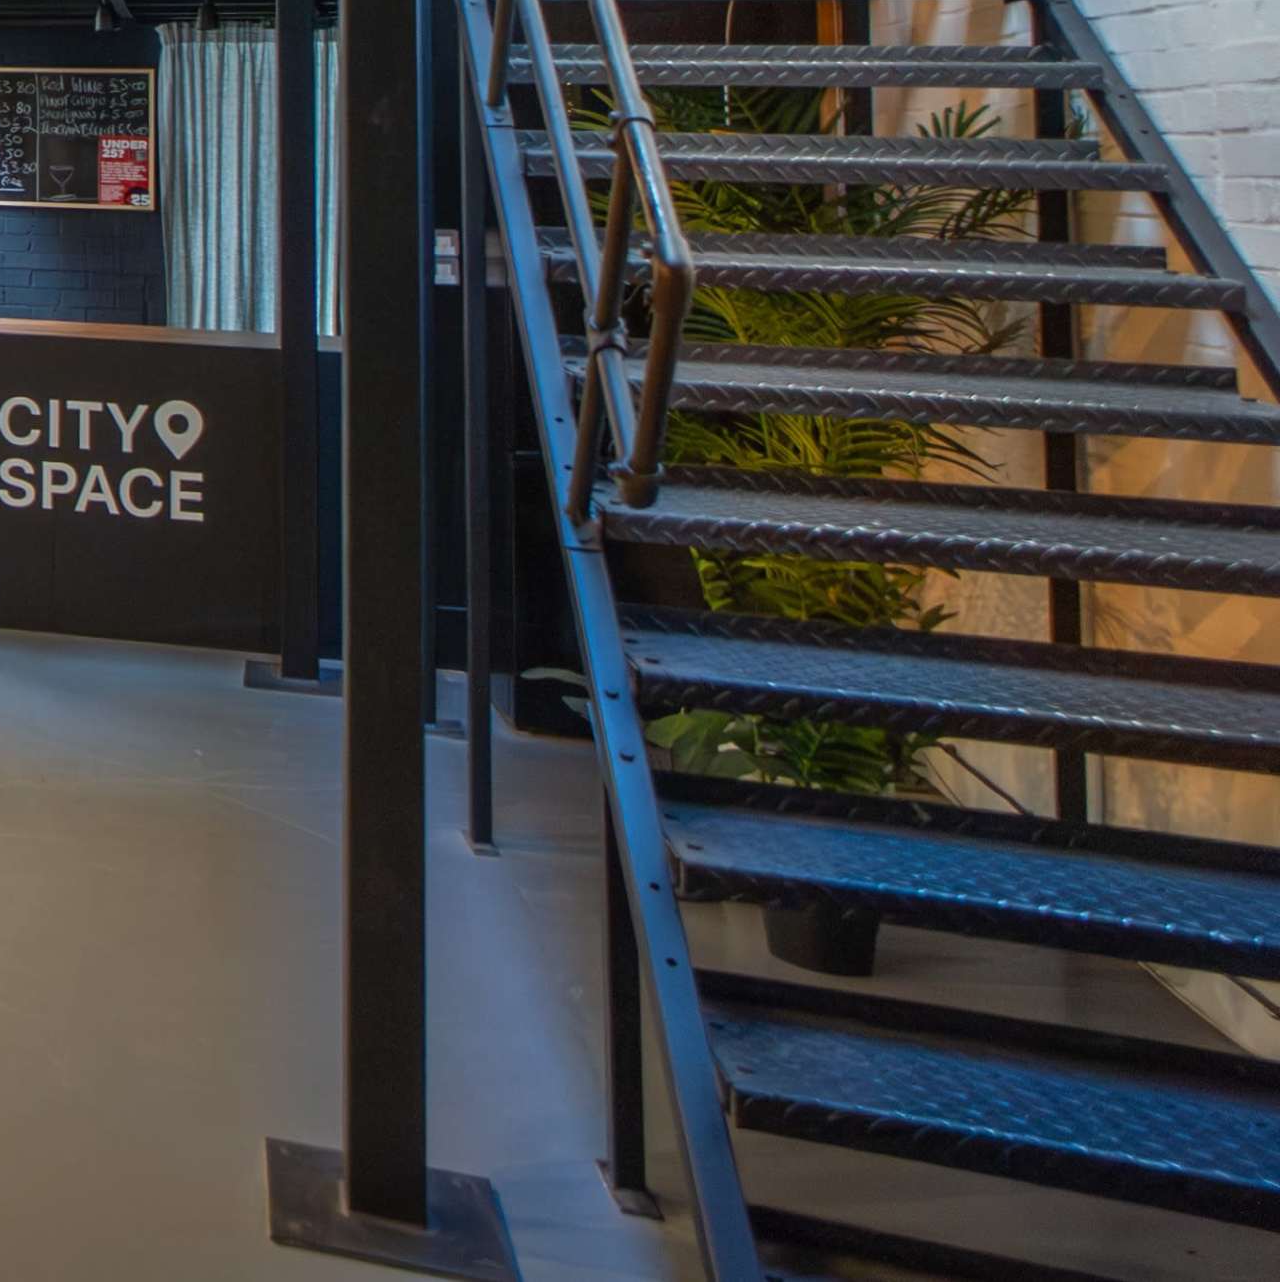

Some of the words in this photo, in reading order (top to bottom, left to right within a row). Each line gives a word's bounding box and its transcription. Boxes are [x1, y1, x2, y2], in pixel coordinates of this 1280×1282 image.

[101, 139, 148, 150] UNDER
[101, 149, 125, 159] 25?
[130, 193, 151, 207] 25
